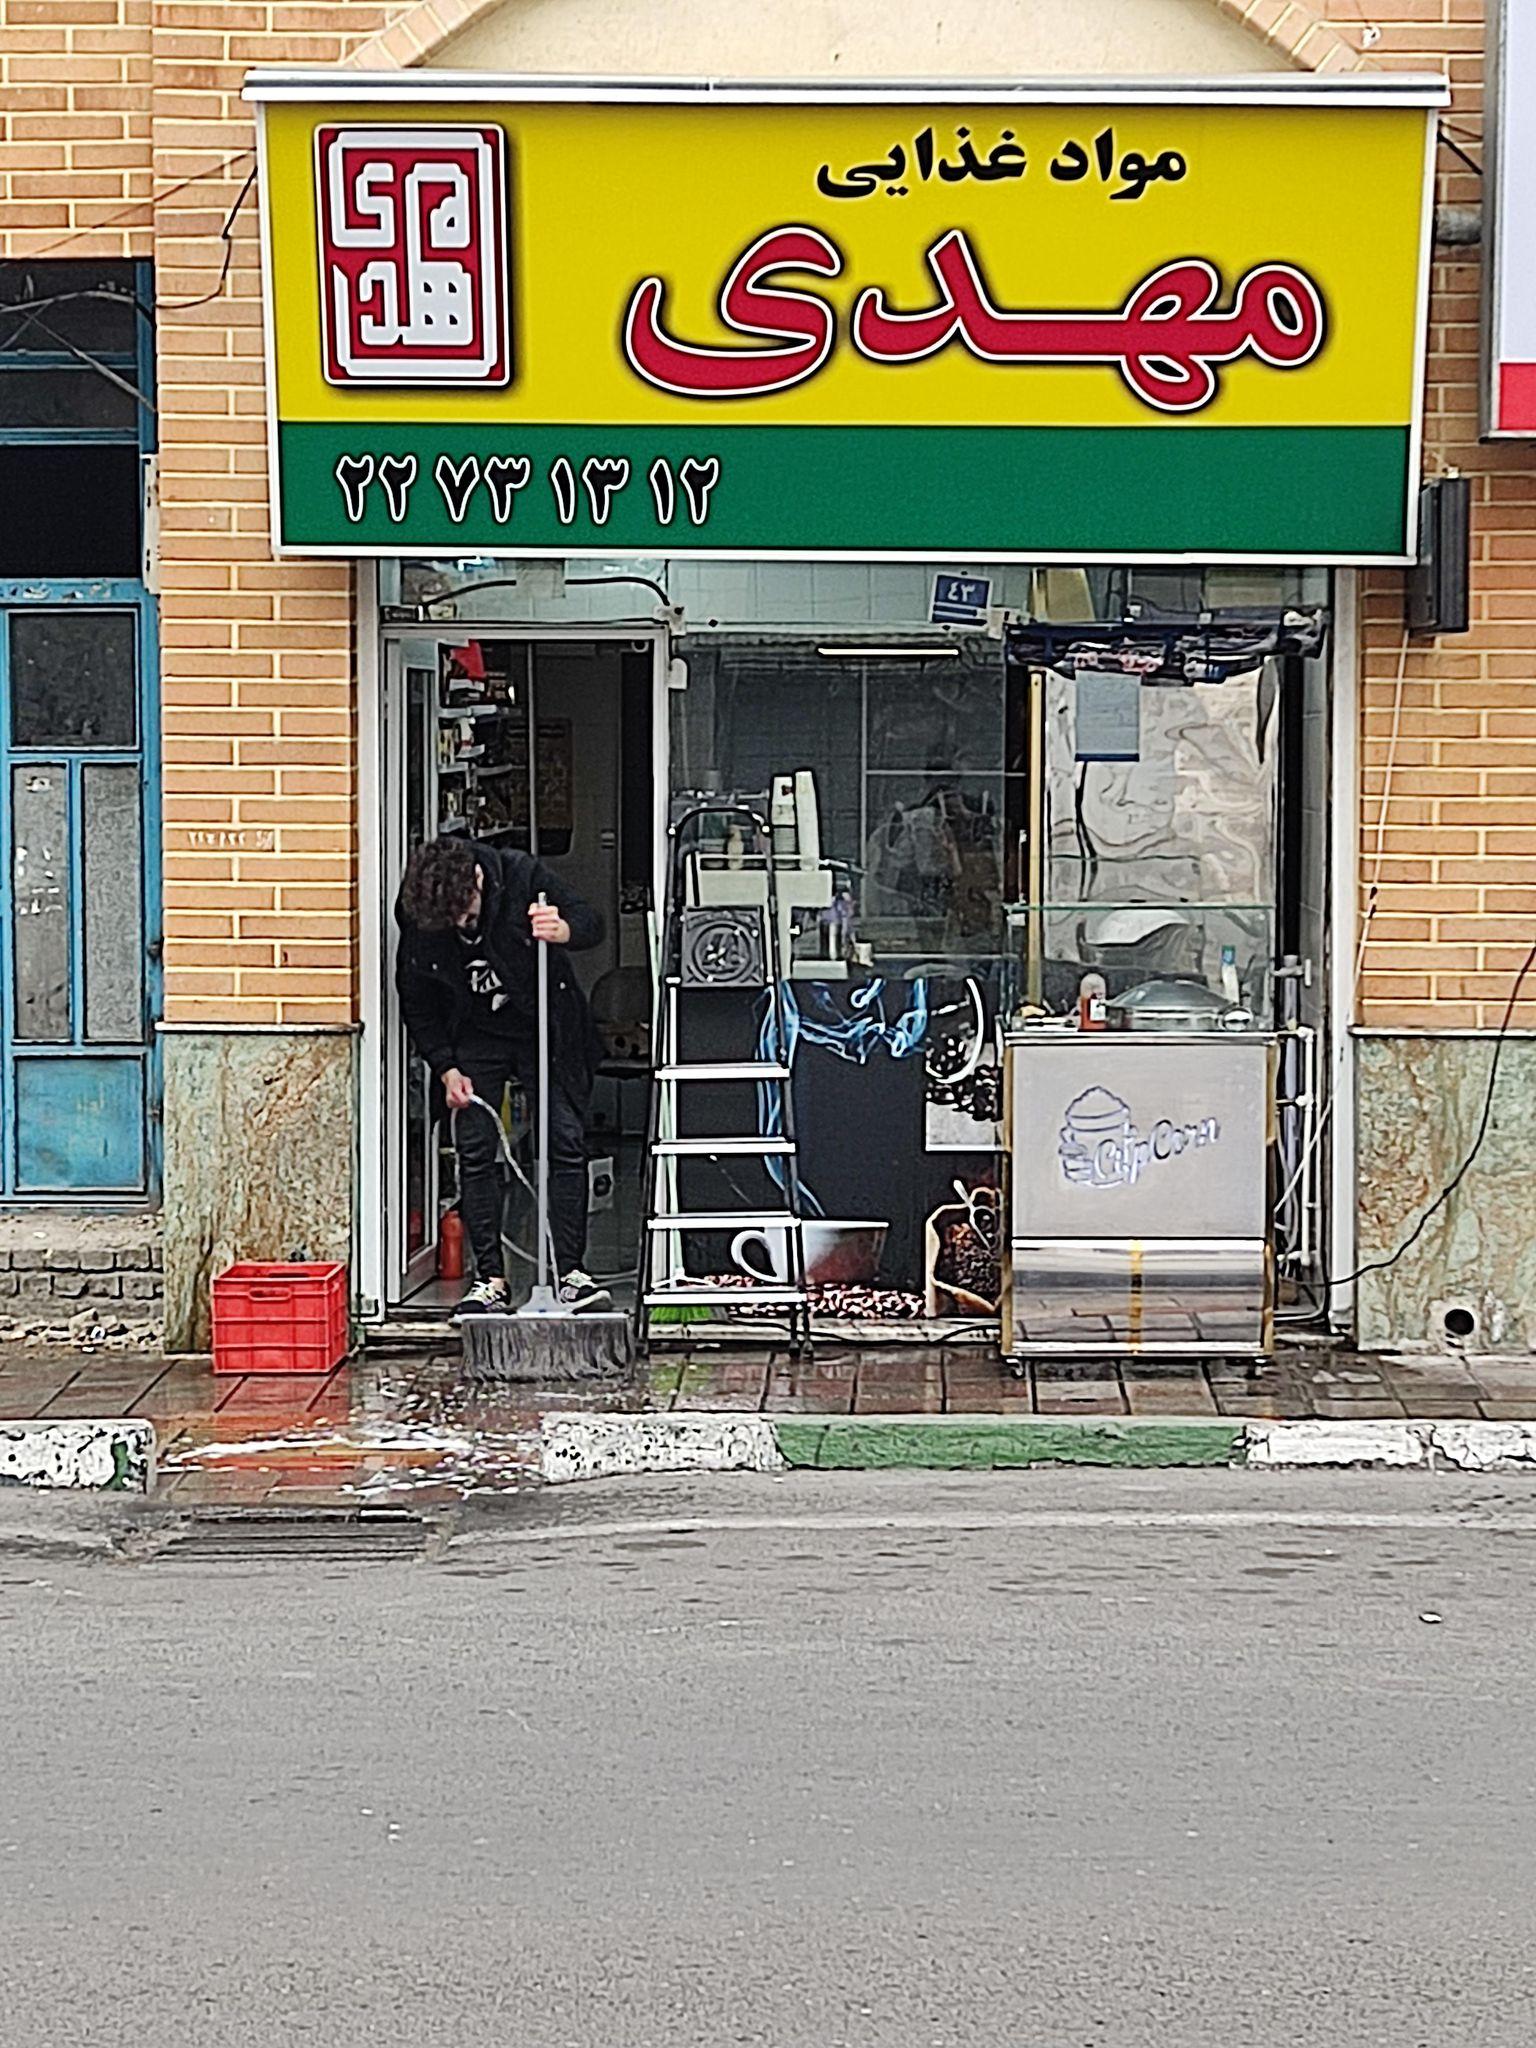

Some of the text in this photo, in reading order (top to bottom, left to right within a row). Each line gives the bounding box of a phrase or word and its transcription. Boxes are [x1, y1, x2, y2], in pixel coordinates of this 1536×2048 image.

[816, 127, 1187, 200] مواد غذایی
[624, 225, 1324, 413] مهدی
[335, 454, 720, 525] ۲۲ ۷۳ ۱۳ ۱۲
[1149, 1117, 1221, 1162] Corn
